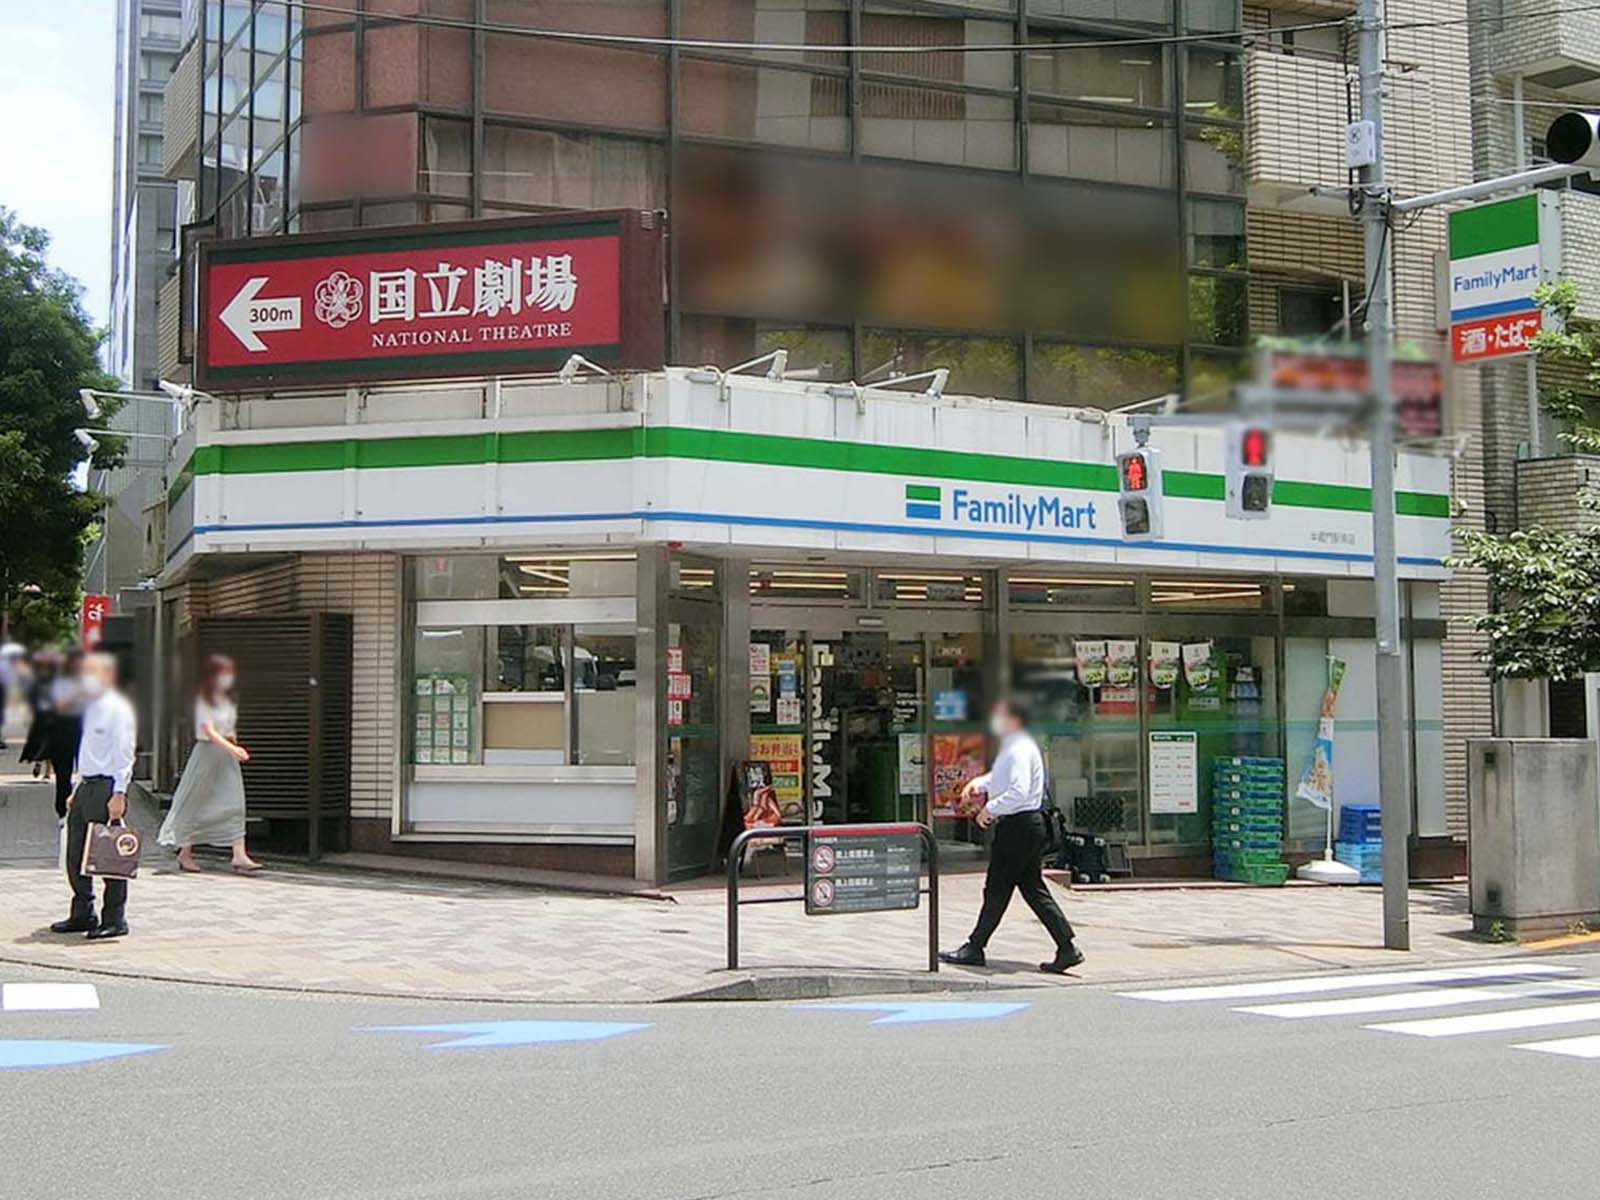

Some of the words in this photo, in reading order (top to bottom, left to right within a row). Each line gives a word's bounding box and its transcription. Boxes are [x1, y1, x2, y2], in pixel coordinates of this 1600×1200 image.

[369, 254, 578, 324] 国立劇場
[1453, 264, 1538, 293] FamilyMart
[250, 307, 293, 323] 300m
[371, 328, 473, 348] NATIONAL
[479, 323, 572, 341] THEATRE
[953, 489, 1096, 530] FamilyMart
